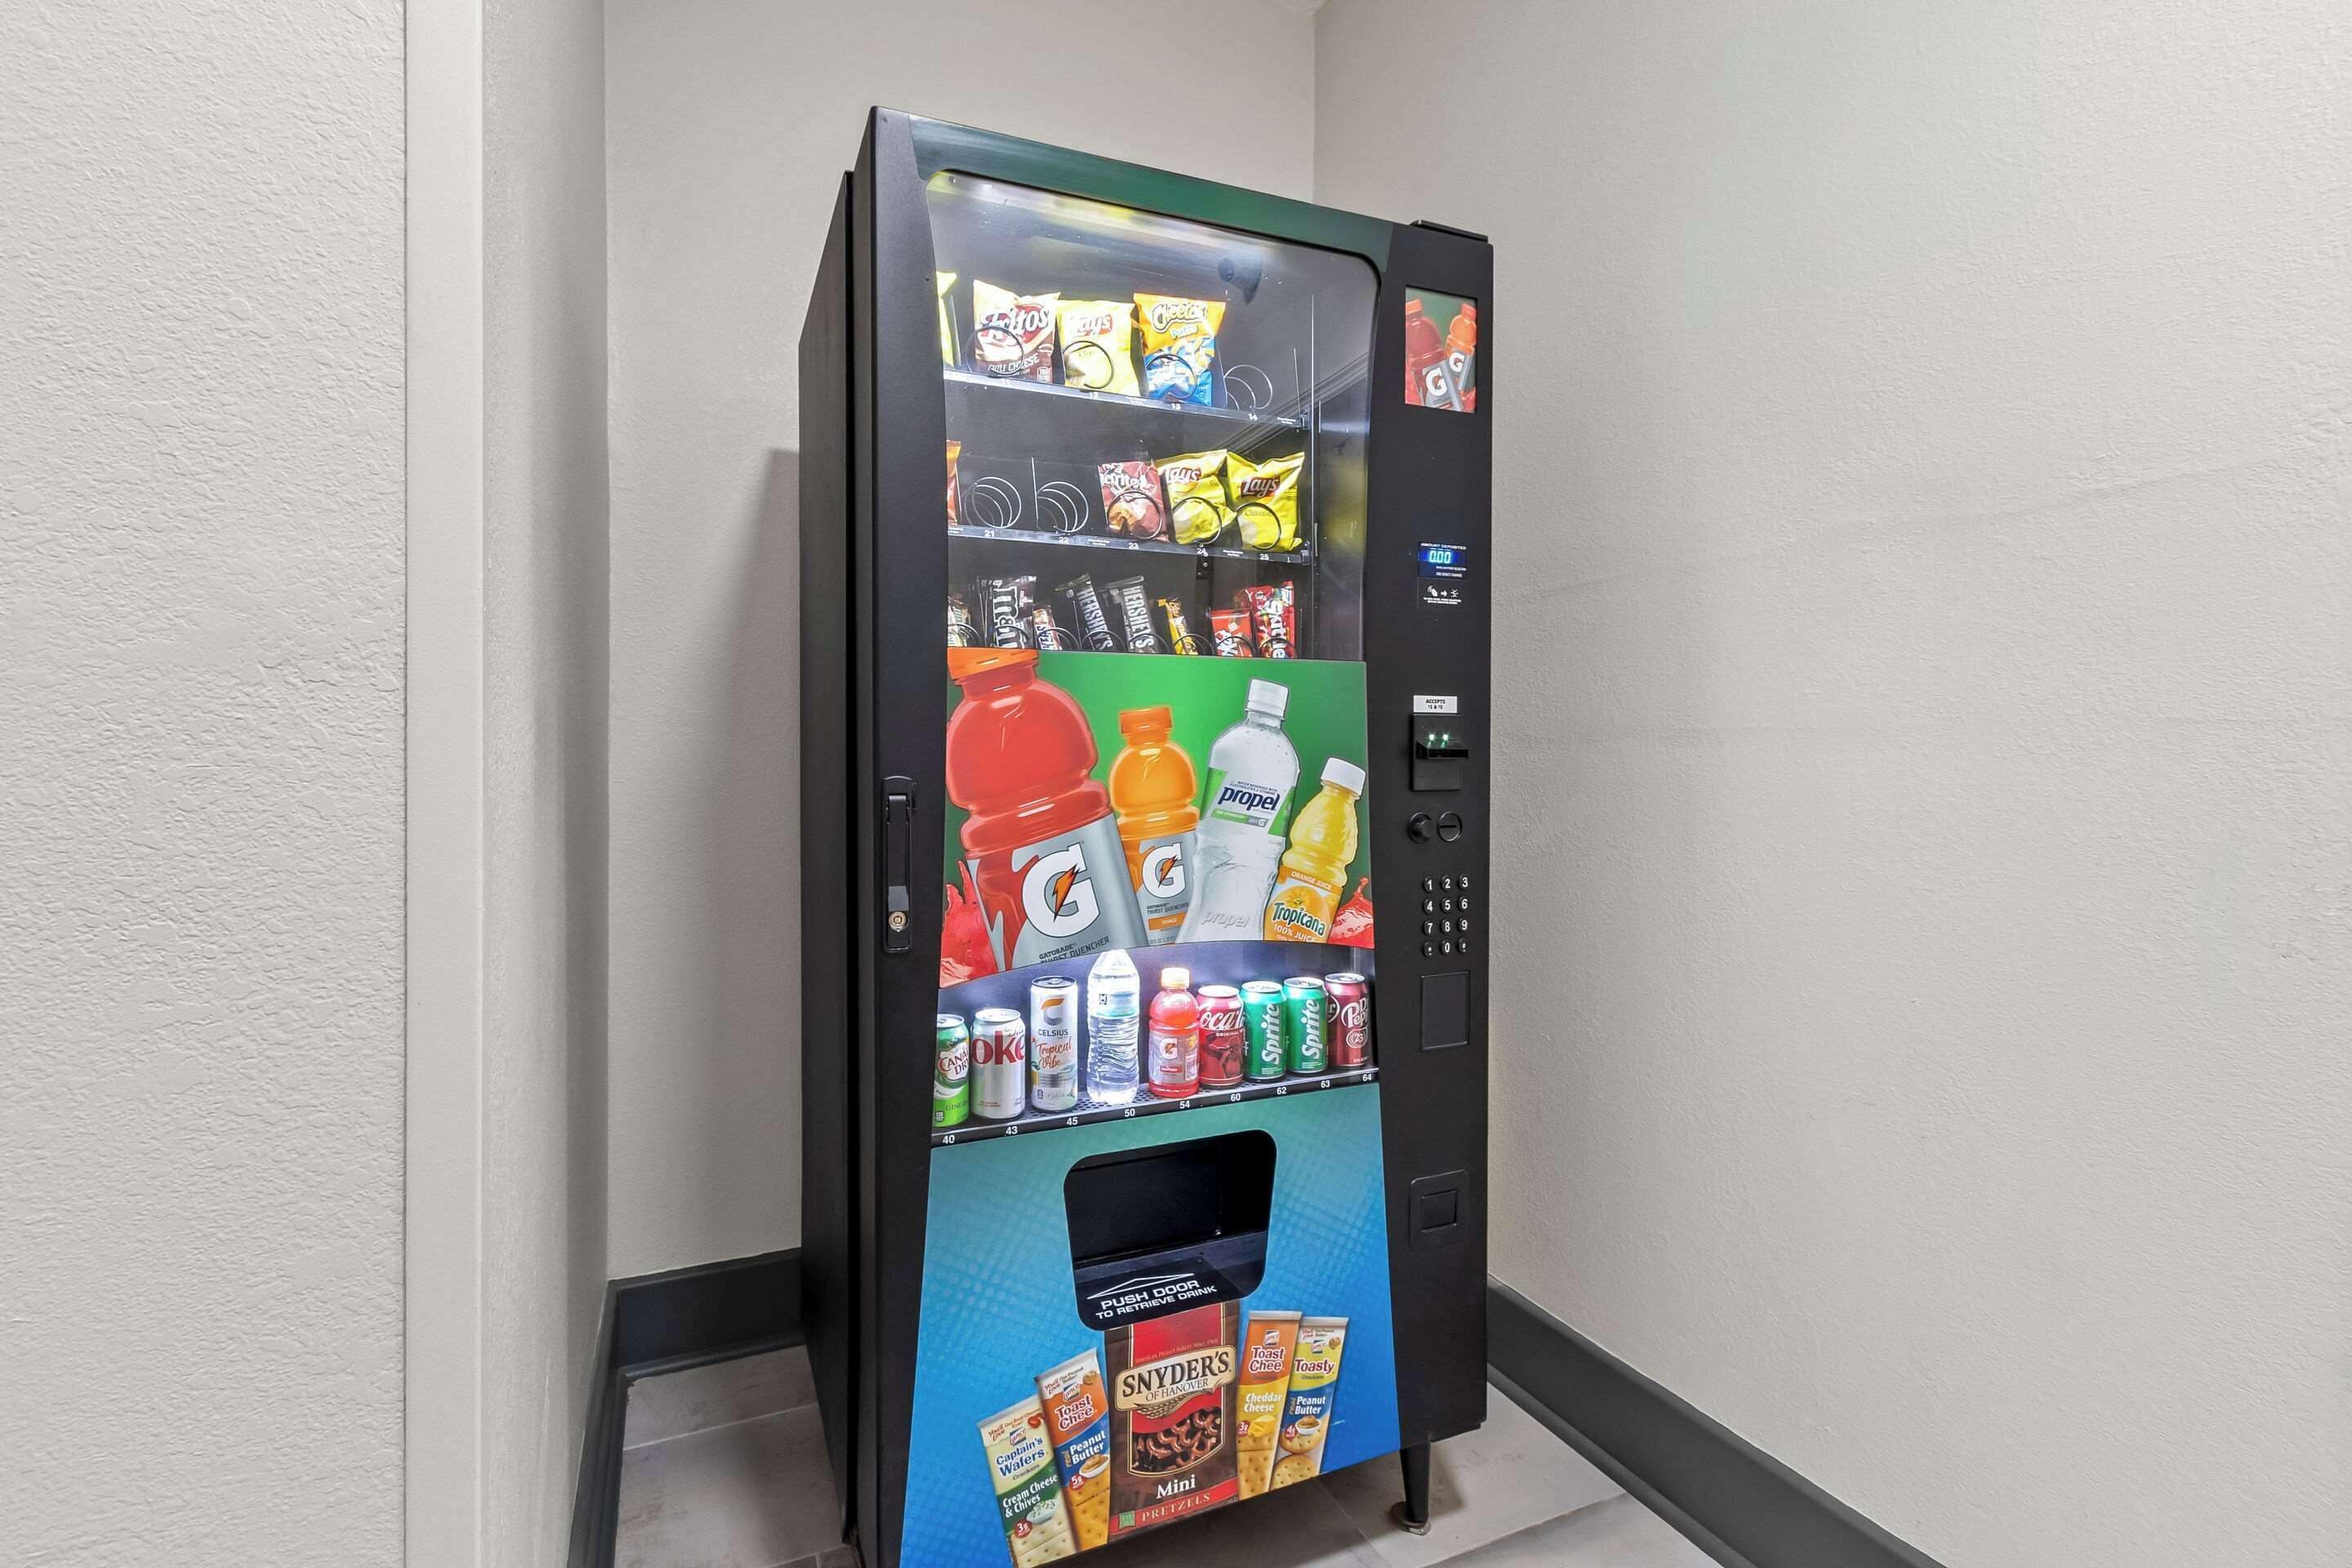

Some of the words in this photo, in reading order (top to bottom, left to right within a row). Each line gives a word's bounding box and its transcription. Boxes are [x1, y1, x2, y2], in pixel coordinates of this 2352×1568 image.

[1152, 301, 1207, 332] Cheetos
[1248, 412, 1258, 421] 14
[1243, 476, 1279, 497] Lay's
[1058, 536, 1068, 544] 22
[1218, 786, 1281, 811] propel
[1142, 842, 1187, 898] G
[1291, 871, 1316, 883] ORANGE
[1022, 842, 1100, 938] G
[1428, 880, 1432, 890] 1
[1445, 878, 1450, 889] 2
[1462, 877, 1468, 888] 3
[1427, 901, 1432, 911] 4
[1445, 900, 1450, 911] 5
[1462, 898, 1468, 909] 6
[1272, 902, 1326, 937] Tropicana
[1428, 923, 1433, 934] 7
[1445, 921, 1450, 932] 8
[1462, 920, 1468, 930] 9
[1274, 924, 1294, 936] 100%
[1039, 943, 1074, 960] GATORADE
[1070, 936, 1110, 959] QUENCHER
[1445, 942, 1450, 953] 0
[1260, 1003, 1282, 1065] Sprite
[1301, 999, 1323, 1059] Sprite
[1036, 1037, 1071, 1056] Tropical
[1321, 1080, 1330, 1088] 63
[1362, 1073, 1372, 1081] 64
[1231, 1094, 1241, 1102] 60
[1276, 1087, 1286, 1095] 62
[1006, 1125, 1018, 1134] 43
[1067, 1117, 1078, 1125] 45
[942, 1135, 955, 1144] 40
[1095, 1309, 1113, 1320] TO
[1116, 1295, 1175, 1315] RETRIEVE
[1178, 1285, 1218, 1300] DRINK
[1100, 1291, 1149, 1310] PUSH
[1152, 1280, 1200, 1297] DOOR
[1251, 1346, 1285, 1361] Toast
[1122, 1351, 1229, 1397] SNYDER'S
[1249, 1359, 1282, 1373] Chee
[1294, 1358, 1335, 1375] Toasty
[1145, 1390, 1160, 1402] OF
[1161, 1378, 1209, 1397] HANOVER
[1246, 1392, 1282, 1402] Cheddar
[1054, 1394, 1092, 1419] Toast
[1244, 1403, 1274, 1412] Cheese
[1294, 1405, 1322, 1414] Butter
[1297, 1396, 1326, 1405] Peanut
[1058, 1406, 1094, 1431] Chee
[996, 1437, 1043, 1465] Captain's
[1070, 1430, 1106, 1455] Peanut
[1000, 1449, 1045, 1477] Wafers
[1071, 1442, 1104, 1465] Butter
[1003, 1489, 1029, 1508] Cream
[1030, 1474, 1058, 1494] Cheese
[1156, 1473, 1196, 1499] Mini
[1005, 1508, 1013, 1517] &
[1014, 1494, 1040, 1512] Chives
[1142, 1492, 1211, 1521] PRETZELS
